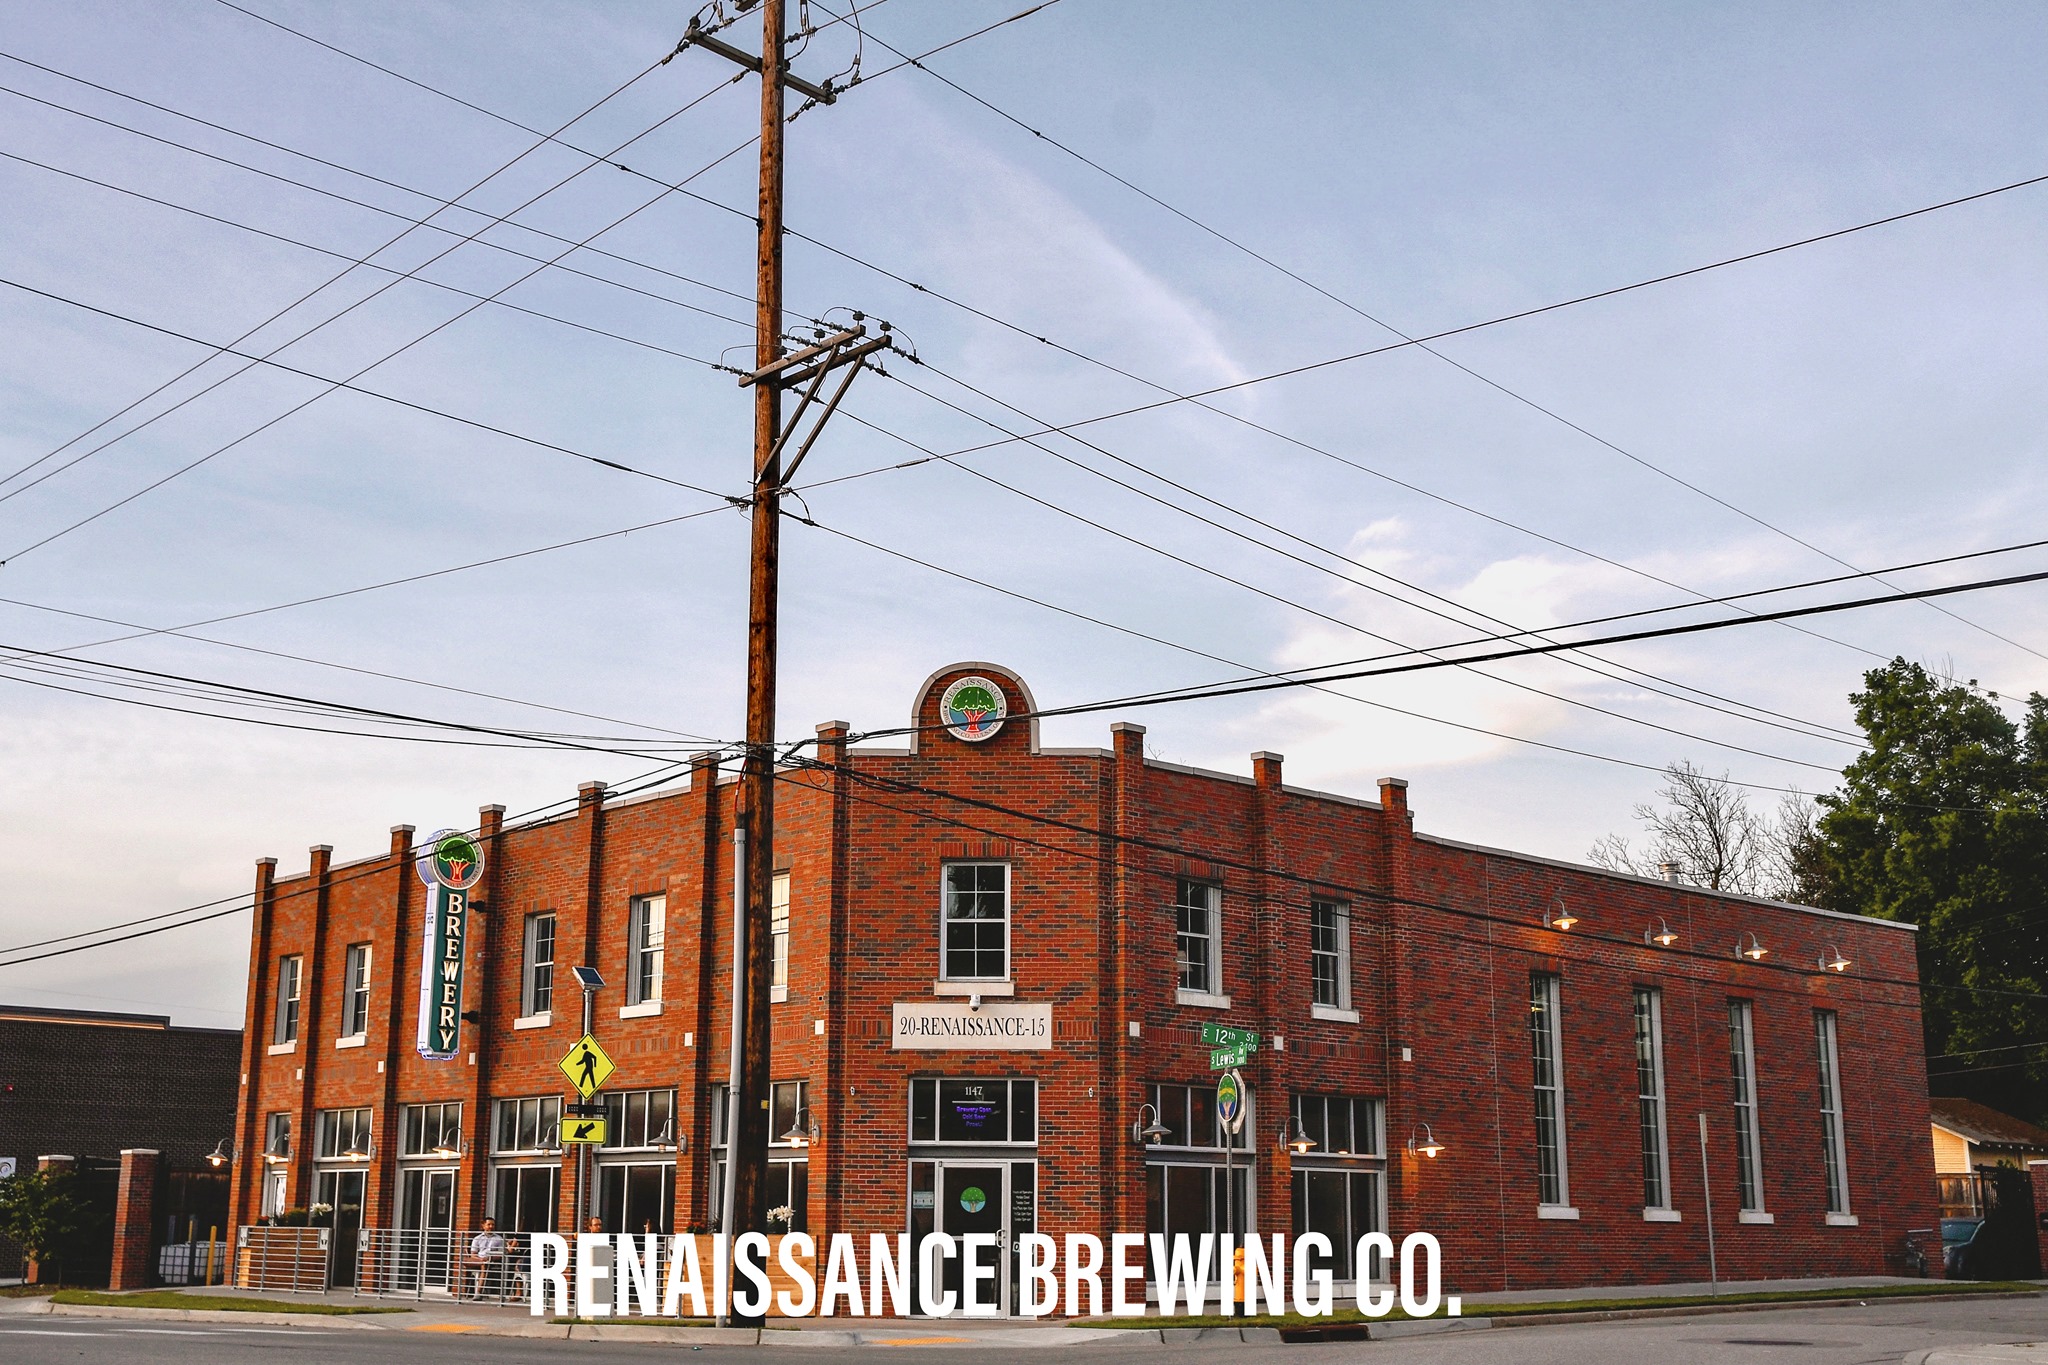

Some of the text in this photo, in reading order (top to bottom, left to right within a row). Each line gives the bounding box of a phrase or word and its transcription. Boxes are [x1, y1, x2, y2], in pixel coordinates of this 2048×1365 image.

[945, 680, 1001, 703] RENAISSANCE
[439, 893, 463, 1050] BREWERY
[900, 1016, 1045, 1037] 20-RENAISSANCE-15
[1203, 1028, 1254, 1044] E 12th St
[1211, 1055, 1215, 1065] S
[1216, 1050, 1235, 1067] Lewis
[965, 1086, 983, 1096] 1147
